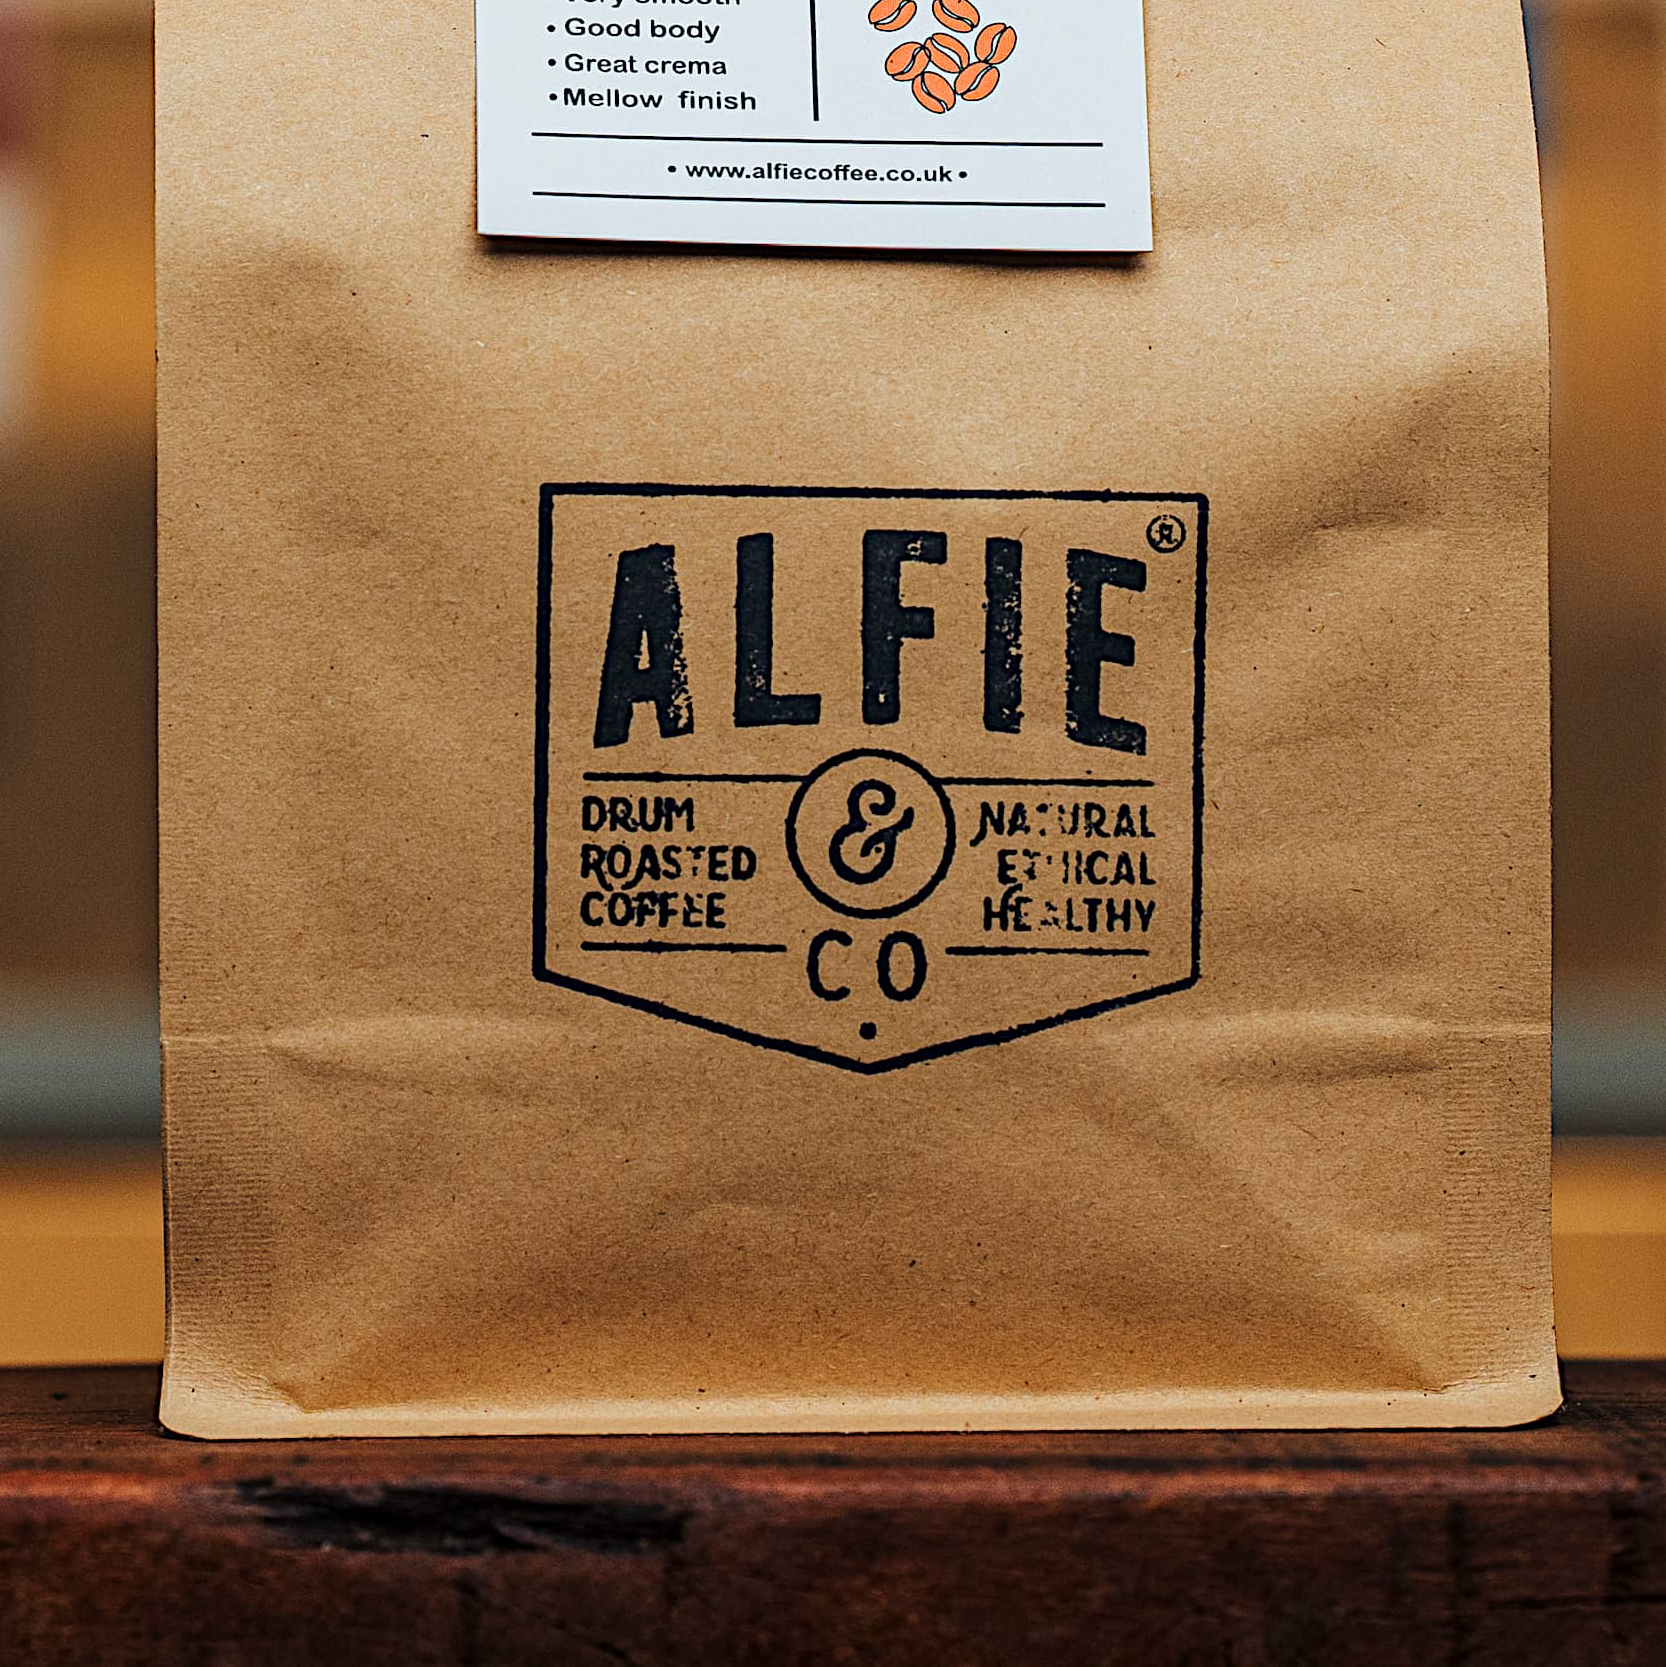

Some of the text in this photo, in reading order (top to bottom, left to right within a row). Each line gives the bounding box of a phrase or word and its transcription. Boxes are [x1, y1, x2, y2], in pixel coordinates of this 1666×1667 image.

[564, 17, 720, 44] Good body
[564, 53, 727, 76] Great crema
[563, 87, 756, 111] Mellow finish
[685, 162, 953, 183] www.alfiecoffee.co.uk
[592, 527, 1145, 756] ALFIE
[581, 795, 695, 832] DRUM
[828, 778, 916, 886] &
[580, 843, 757, 891] ROASTED
[580, 891, 726, 928] COFFEE
[805, 927, 929, 1002] CO
